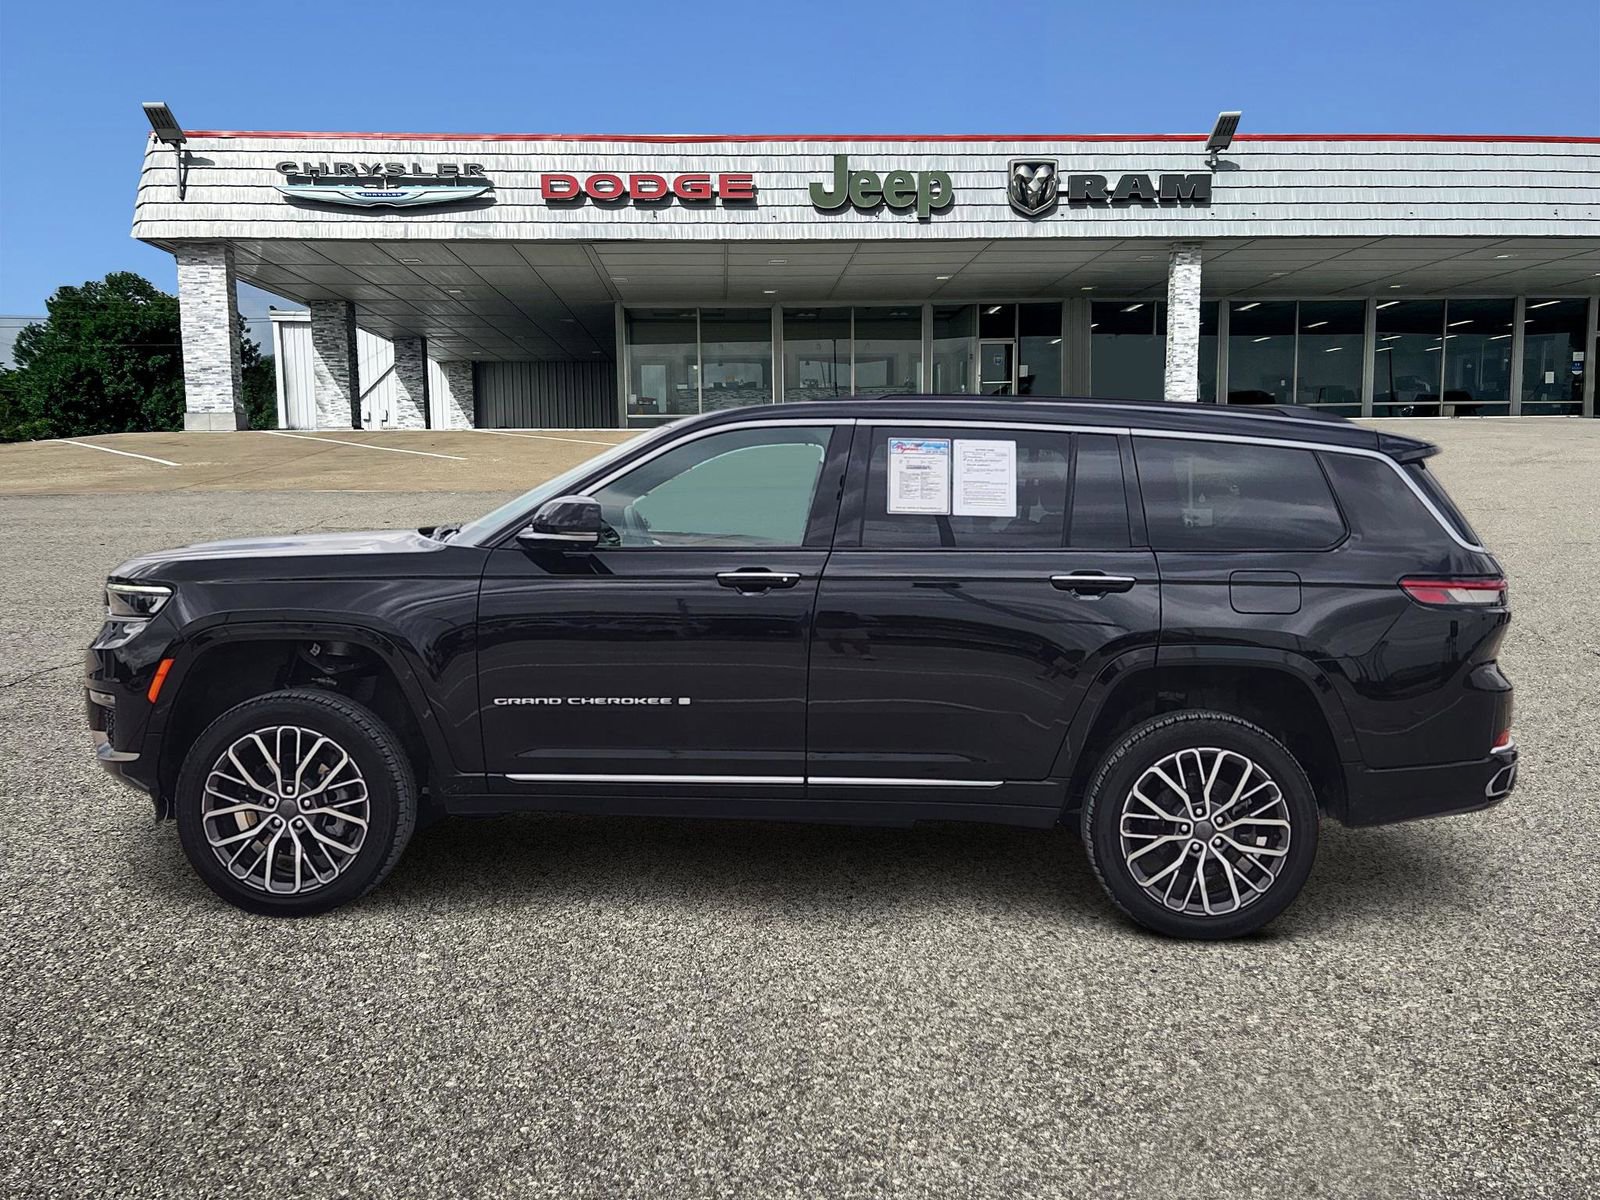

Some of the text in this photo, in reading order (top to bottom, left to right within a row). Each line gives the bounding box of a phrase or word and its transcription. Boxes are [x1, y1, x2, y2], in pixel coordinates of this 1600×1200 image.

[275, 161, 486, 178] CHRYSLER
[540, 173, 754, 200] DODGE
[808, 154, 953, 219] Jeep
[1067, 173, 1213, 200] RAM
[493, 697, 563, 706] GRAND
[567, 697, 673, 706] CHEROKEE
